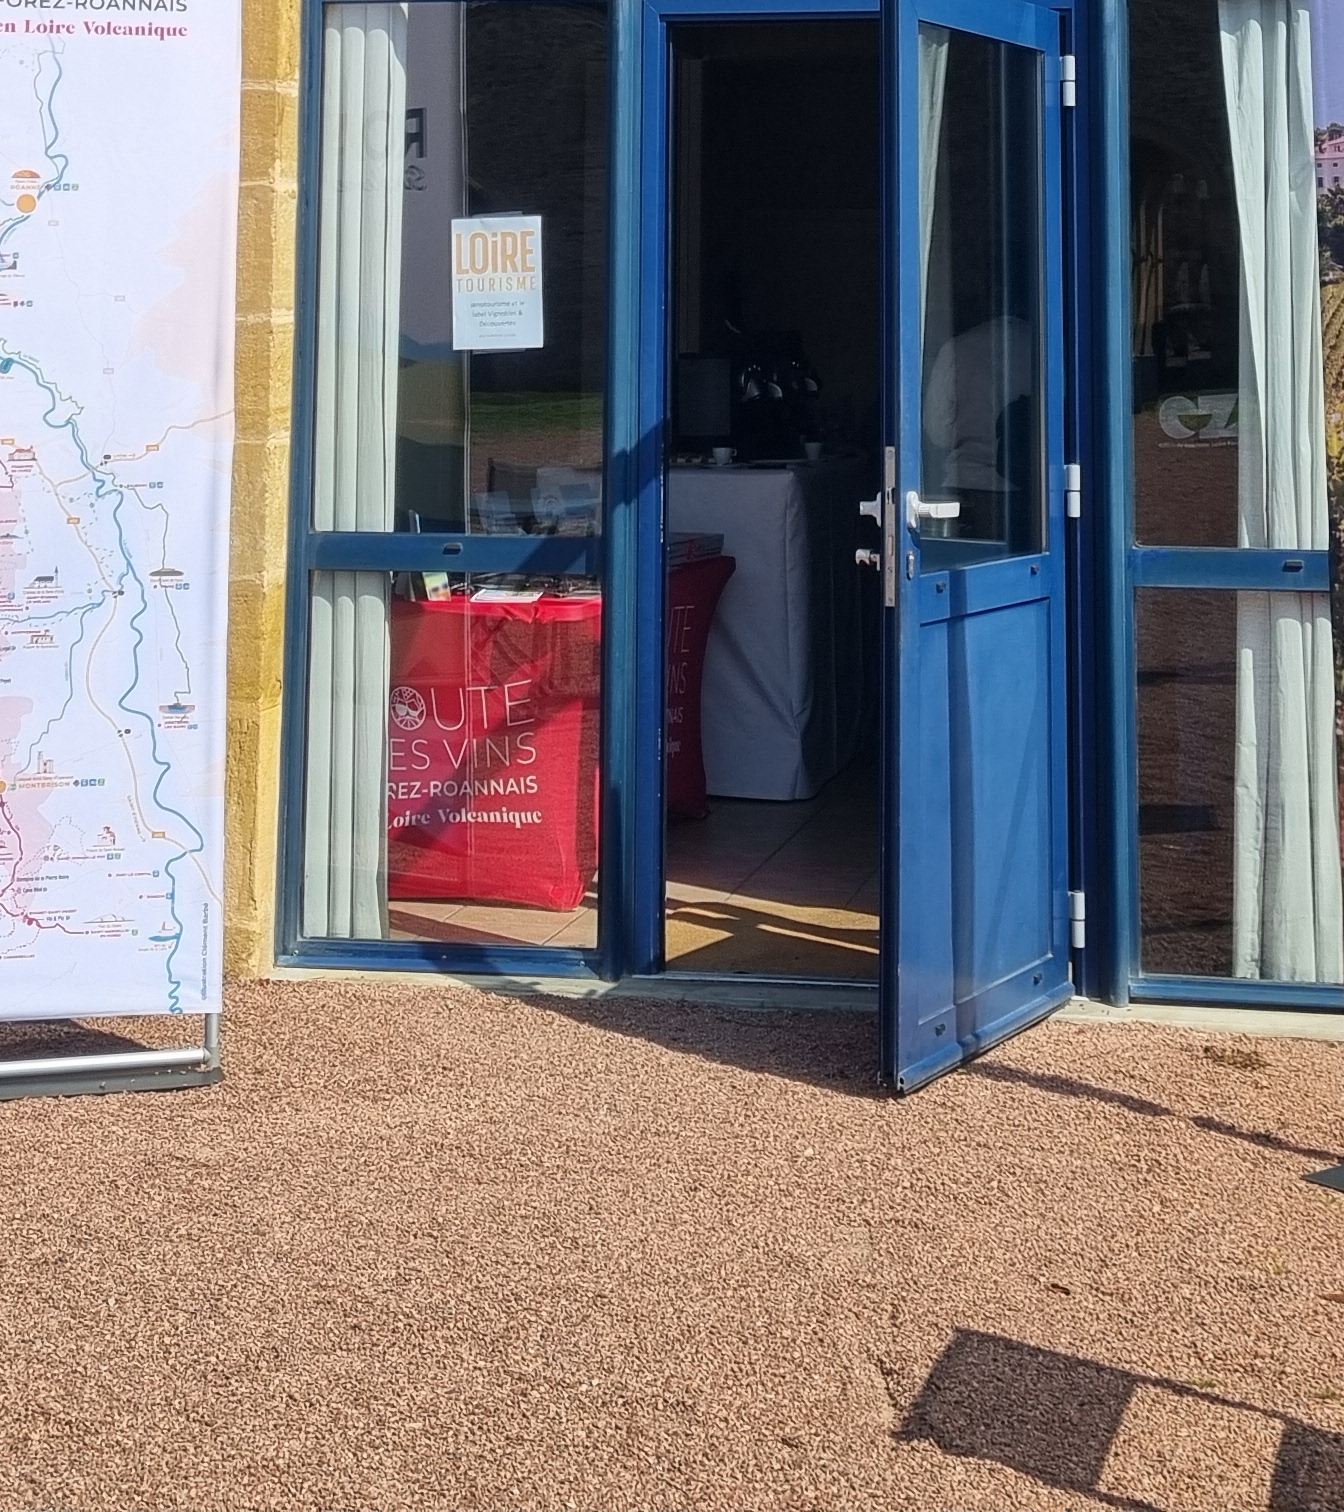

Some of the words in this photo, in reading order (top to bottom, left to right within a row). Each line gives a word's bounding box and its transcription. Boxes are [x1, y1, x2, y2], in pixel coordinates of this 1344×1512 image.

[24, 20, 75, 34] Loire
[84, 21, 188, 41] Volcanique
[456, 276, 536, 292] TOURISME
[390, 679, 535, 731] OUTE
[389, 739, 430, 771] ES
[443, 732, 537, 770] VINS
[18, 781, 70, 789] MONTBRISON
[388, 776, 538, 800] REZ-ROANNAIS
[438, 807, 542, 829] Volcanique
